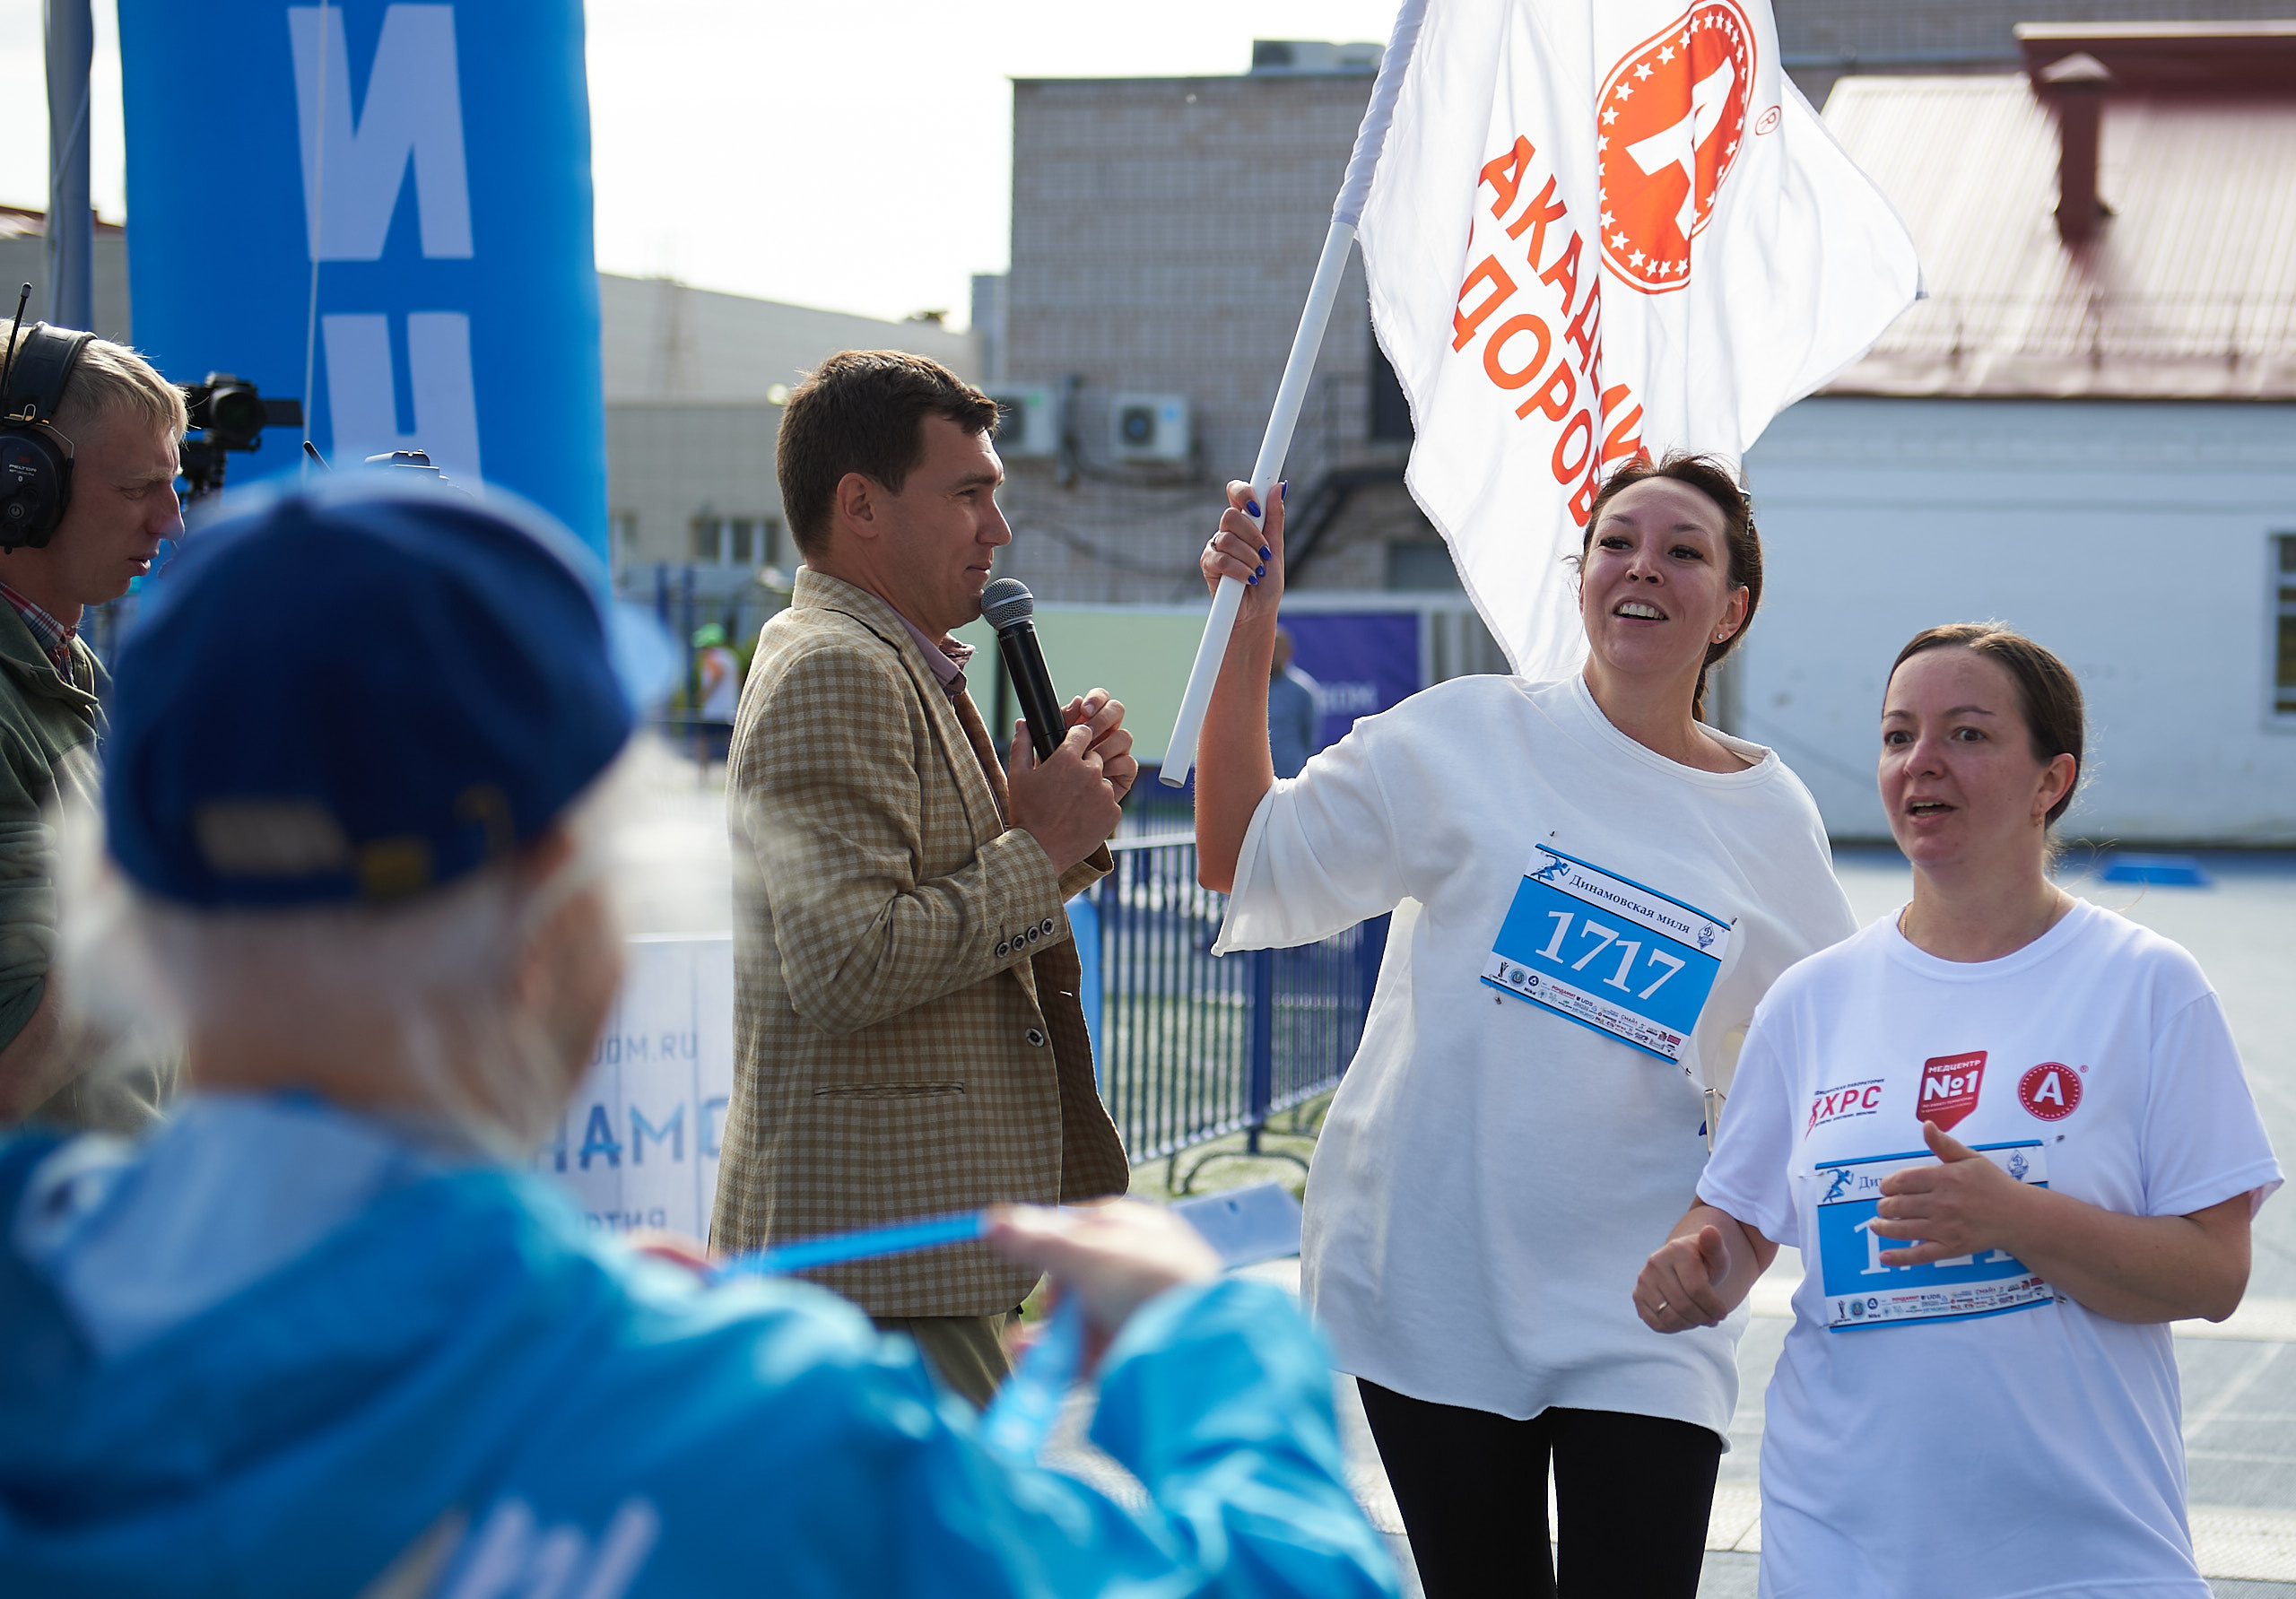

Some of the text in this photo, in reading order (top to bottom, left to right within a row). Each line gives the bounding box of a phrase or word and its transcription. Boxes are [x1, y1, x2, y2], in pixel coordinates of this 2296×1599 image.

[1570, 874, 1692, 934] Динамовская миля
[1535, 910, 1686, 1001] 1717
[1928, 1060, 1981, 1073] МЕДЦЕНТР
